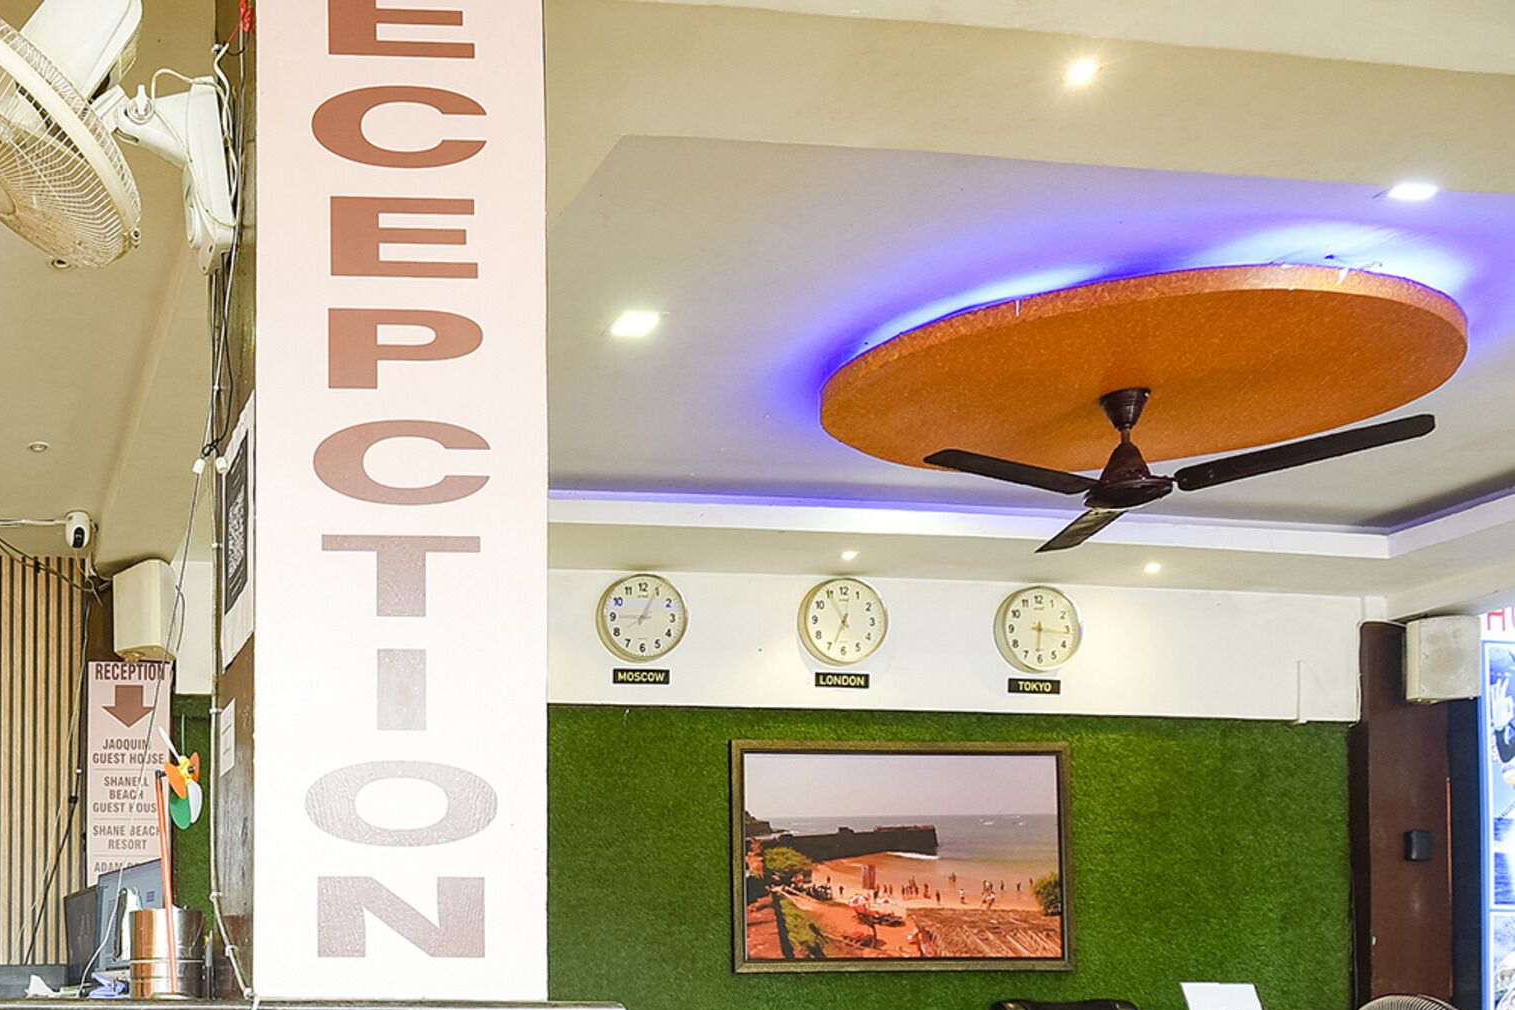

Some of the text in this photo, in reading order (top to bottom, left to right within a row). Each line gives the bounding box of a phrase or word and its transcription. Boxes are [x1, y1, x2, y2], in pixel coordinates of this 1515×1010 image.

[624, 586, 633, 595] 11
[638, 582, 649, 592] 12
[839, 586, 849, 596] 12
[826, 589, 834, 599] 11
[613, 597, 623, 606] 10
[665, 598, 672, 608] 2
[1021, 599, 1029, 608] 11
[1034, 595, 1044, 604] 12
[815, 600, 825, 610] 10
[865, 602, 872, 612] 2
[609, 612, 617, 622] 9
[669, 613, 676, 623] 3
[1011, 609, 1021, 619] 10
[1060, 611, 1066, 620] 2
[811, 615, 818, 624] 9
[869, 617, 875, 627] 3
[613, 627, 620, 637] 8
[665, 628, 672, 638] 4
[1008, 624, 1015, 633] 9
[815, 630, 822, 640] 8
[865, 632, 871, 641] 4
[624, 639, 631, 648] 7
[639, 643, 646, 652] 6
[654, 639, 661, 649] 5
[826, 641, 832, 650] 7
[855, 642, 861, 652] 5
[1012, 639, 1019, 648] 8
[1061, 640, 1067, 648] 4
[840, 646, 846, 655] 6
[1023, 650, 1029, 659] 7
[1051, 650, 1057, 660] 5
[1037, 654, 1043, 664] 6
[95, 663, 165, 680] RECEPTION
[617, 671, 665, 682] MOSCOW
[819, 675, 865, 686] LONDON
[1018, 681, 1052, 692] TOKYO
[93, 753, 126, 764] GUEST
[93, 802, 125, 813] GUEST
[93, 825, 126, 836] SHANE
[108, 839, 147, 850] RESORT
